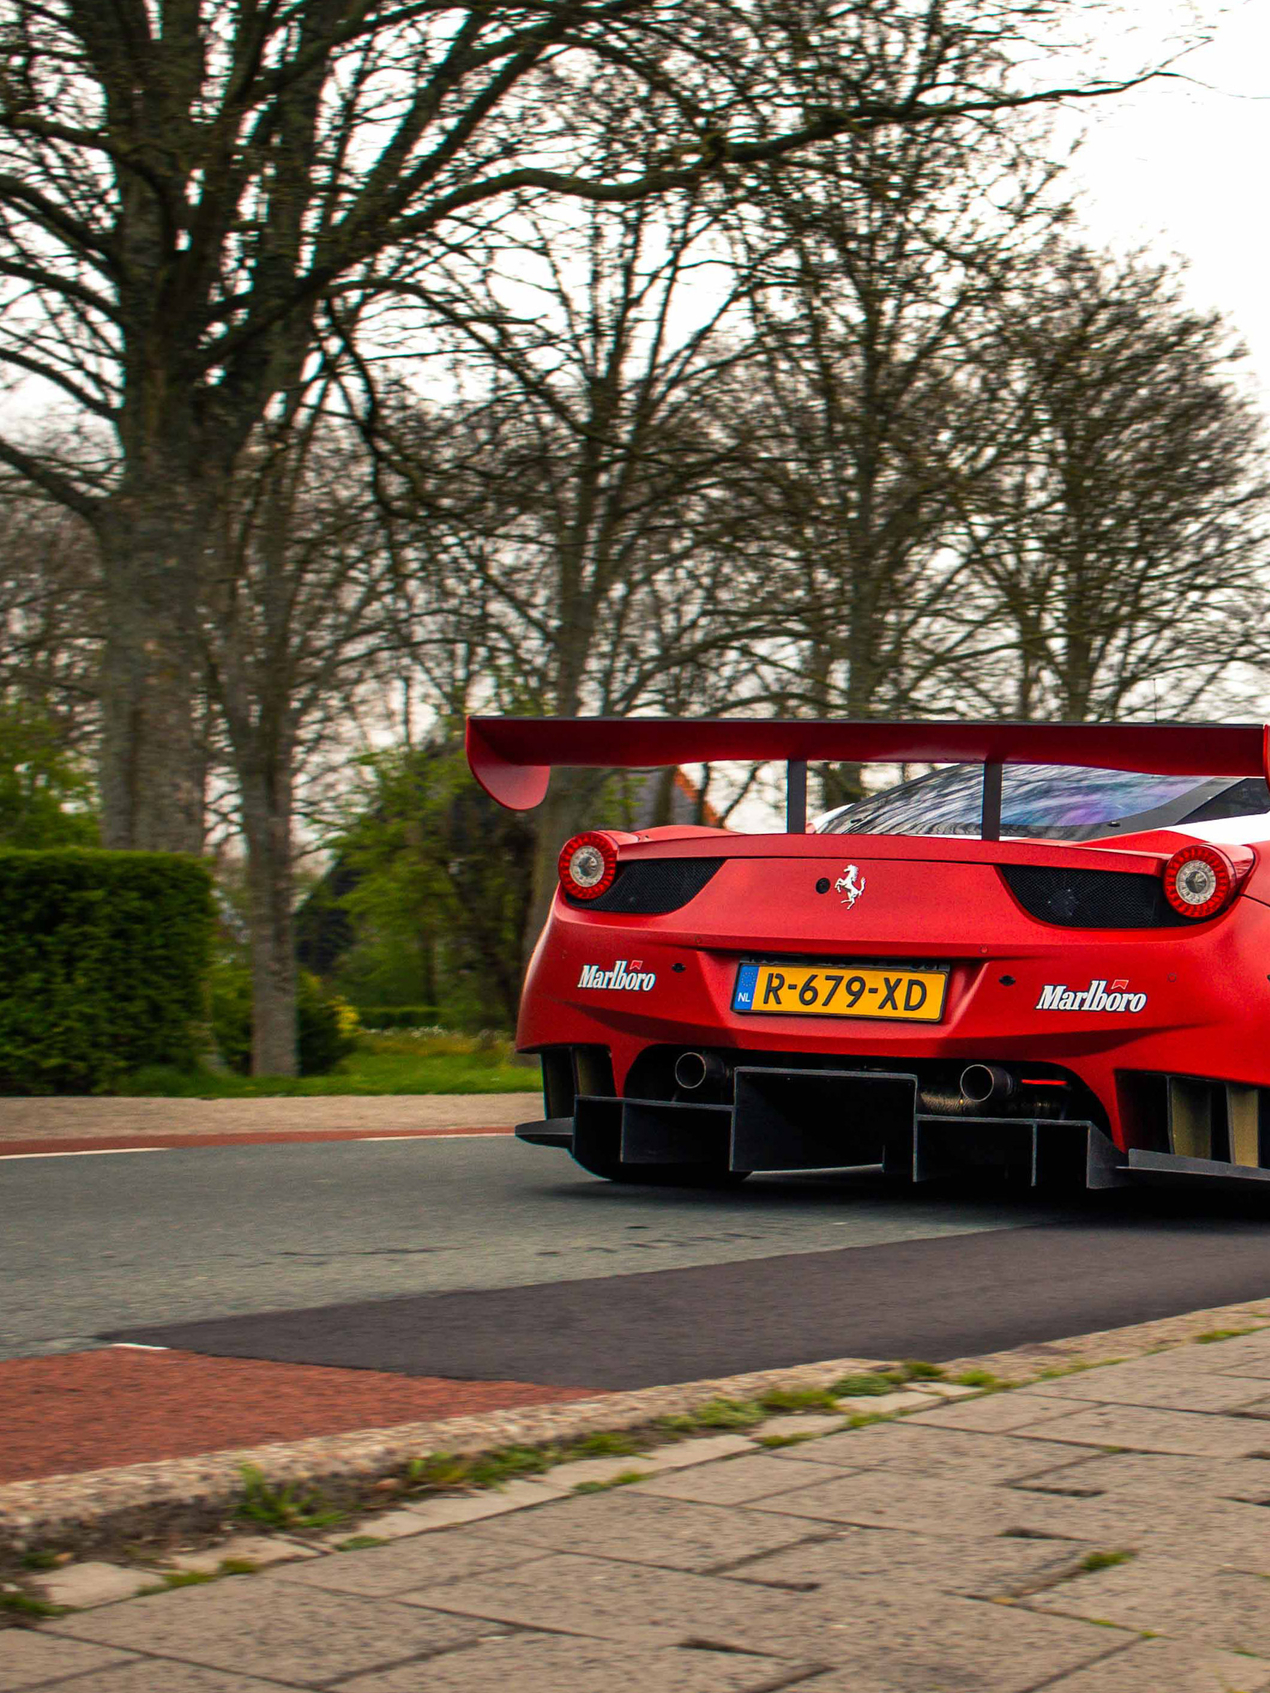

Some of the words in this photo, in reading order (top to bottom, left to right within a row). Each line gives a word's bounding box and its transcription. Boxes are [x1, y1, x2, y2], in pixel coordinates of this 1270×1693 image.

[577, 960, 656, 991] Marlboro
[737, 992, 751, 1003] NL
[763, 972, 927, 1011] R-679-XD
[1035, 980, 1147, 1012] Marlboro
